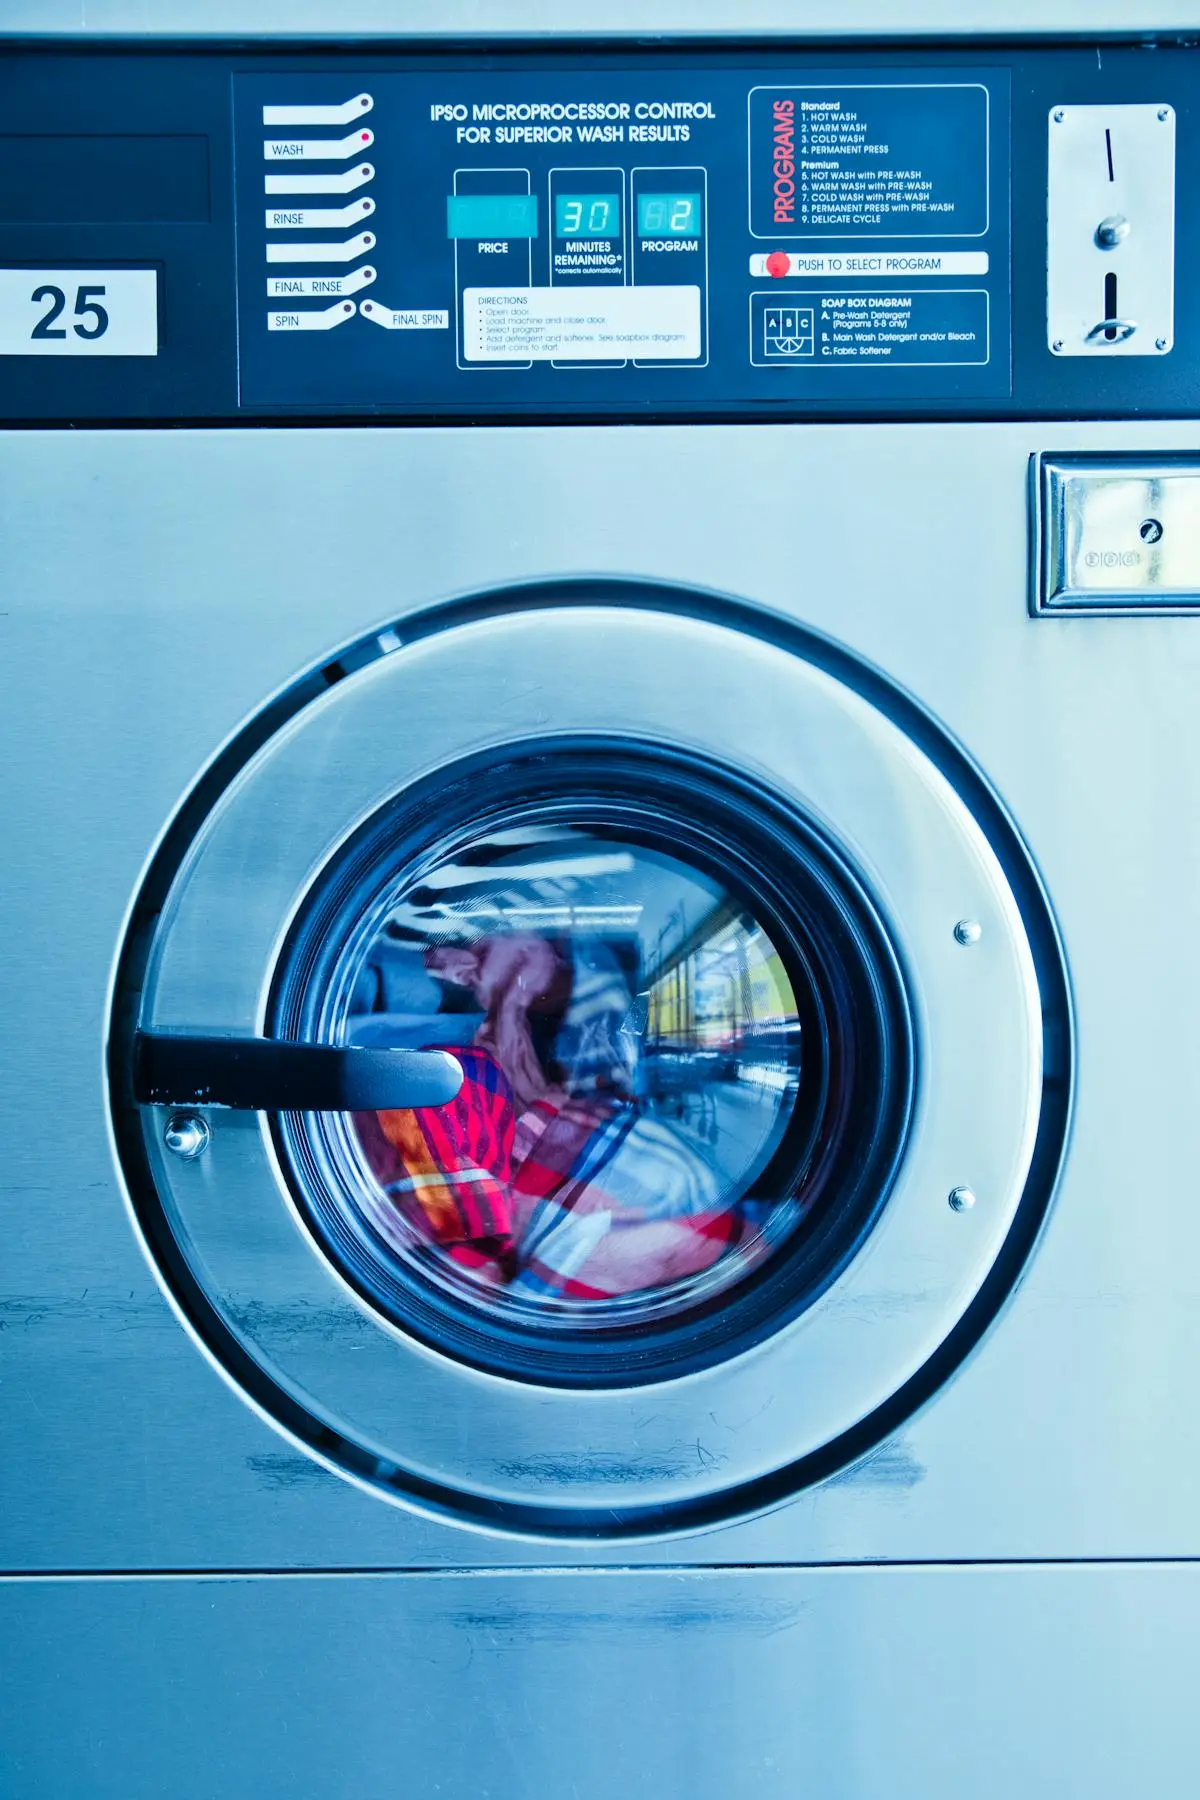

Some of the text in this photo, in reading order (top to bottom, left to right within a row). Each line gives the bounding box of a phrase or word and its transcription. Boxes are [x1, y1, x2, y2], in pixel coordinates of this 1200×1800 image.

[801, 102, 840, 110] Standard
[431, 102, 716, 121] IPSO MICROPROCESSOR CONTROL
[802, 112, 856, 121] 1. HOT WASH
[801, 124, 867, 132] 2. WARM WASH
[457, 124, 690, 143] FOR SUPERIOR WASH RESULTS
[802, 134, 865, 143] 3. COLD WASH
[272, 145, 303, 155] WASH
[801, 144, 888, 154] 4. PERMANENT PRESS
[773, 100, 795, 222] PROGRAMS
[801, 161, 839, 169] Premium
[802, 172, 809, 180] 5.
[811, 172, 828, 180] HOT
[830, 172, 855, 180] WASH
[878, 171, 922, 180] PRE-WASH
[802, 182, 932, 191] 6. WARM WASH with PRE-WASH
[811, 193, 837, 202] COLD
[839, 193, 864, 201] WASH
[866, 193, 884, 201] with
[886, 192, 929, 202] PRE-WASH
[802, 203, 954, 212] 8. PERMANENT PRESS with PRE-WASH
[274, 213, 303, 224] RINSE
[564, 202, 609, 232] 30
[802, 214, 880, 224] 9. DELICATE CYCLE
[478, 242, 508, 253] PRICE
[566, 242, 611, 252] MINUTES
[642, 240, 698, 252] PROGRAM
[798, 258, 941, 270] PUSH TO SELECT PROGRAM
[582, 267, 622, 275] automatically
[275, 281, 342, 292] FINAL RINSE
[478, 297, 528, 305] DIRECTIONS
[822, 298, 912, 308] SOAP BOX DIAGRAM
[31, 285, 108, 339] 25
[821, 311, 910, 321] A. Pre-Wash Detergent
[276, 316, 299, 326] SPIN
[393, 314, 442, 325] FINAL SPIN
[769, 319, 808, 328] A B C
[833, 320, 908, 329] (Programs 5-8 only)
[822, 332, 975, 342] B. Main Wash Detergent and/or Bleach
[822, 346, 891, 355] C. Fabric Softener
